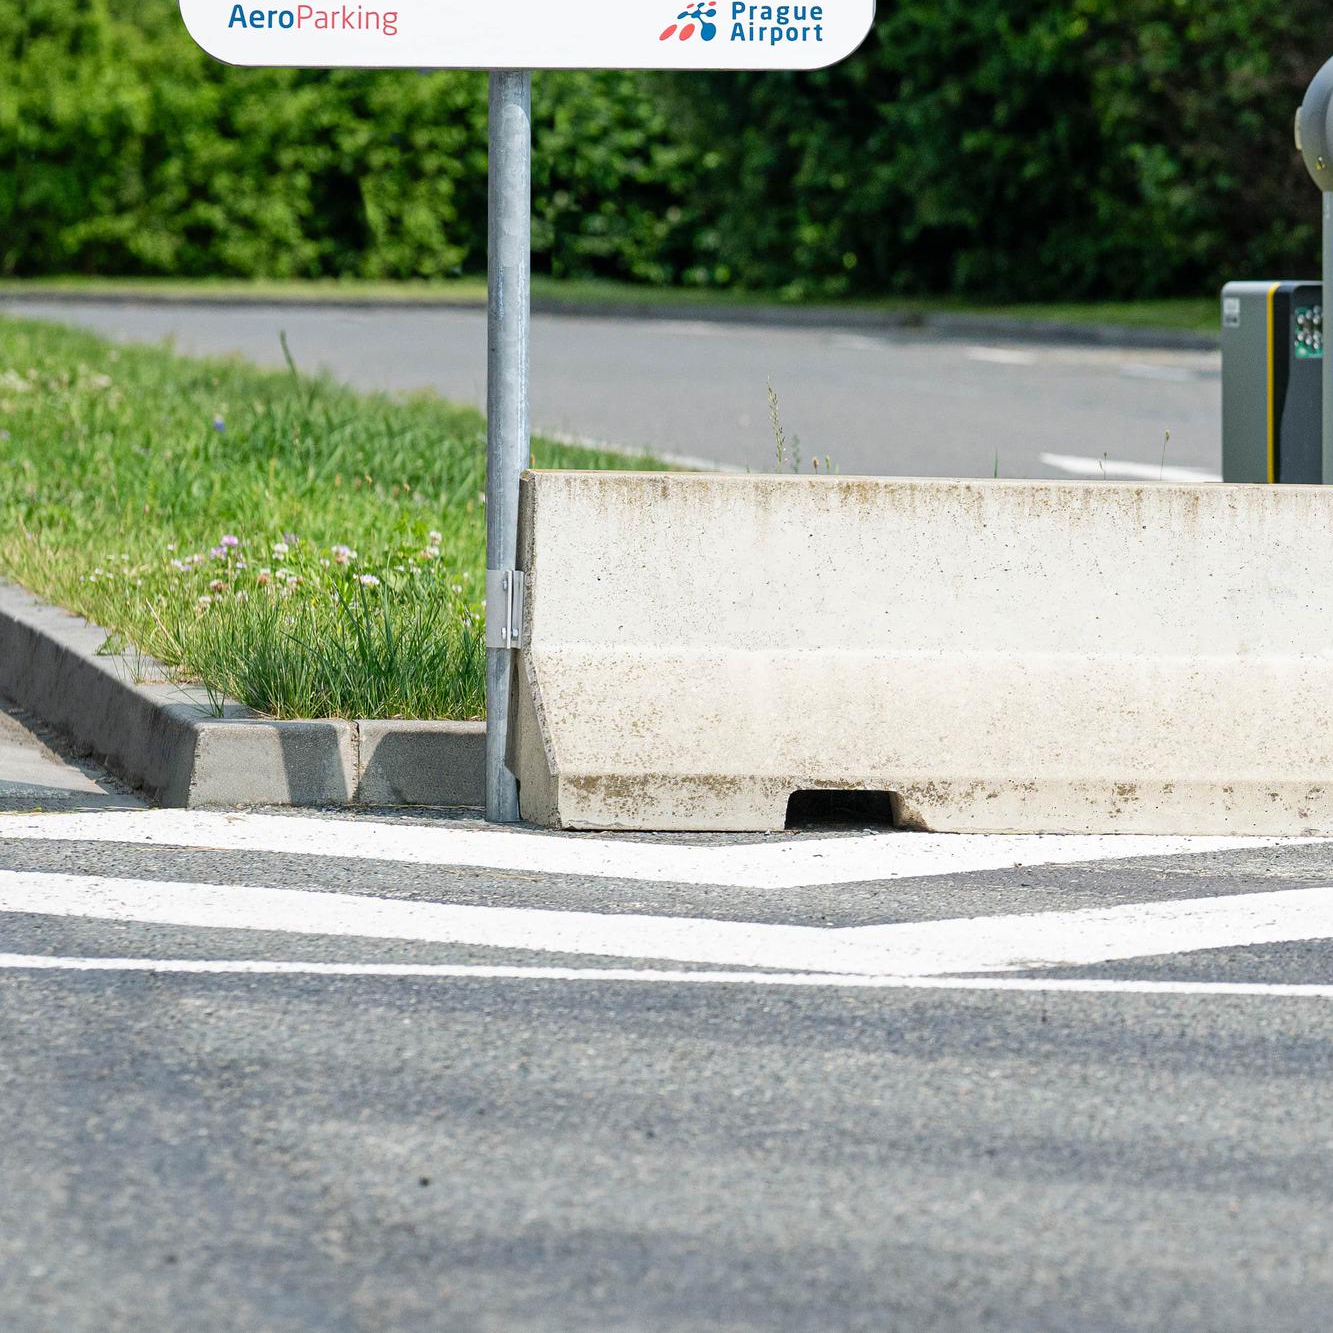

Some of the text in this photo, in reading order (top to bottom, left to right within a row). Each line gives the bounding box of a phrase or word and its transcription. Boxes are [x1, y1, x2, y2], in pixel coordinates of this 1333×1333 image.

[227, 3, 399, 37] AeroParking
[731, 0, 824, 26] Prague
[729, 21, 824, 47] Airport
